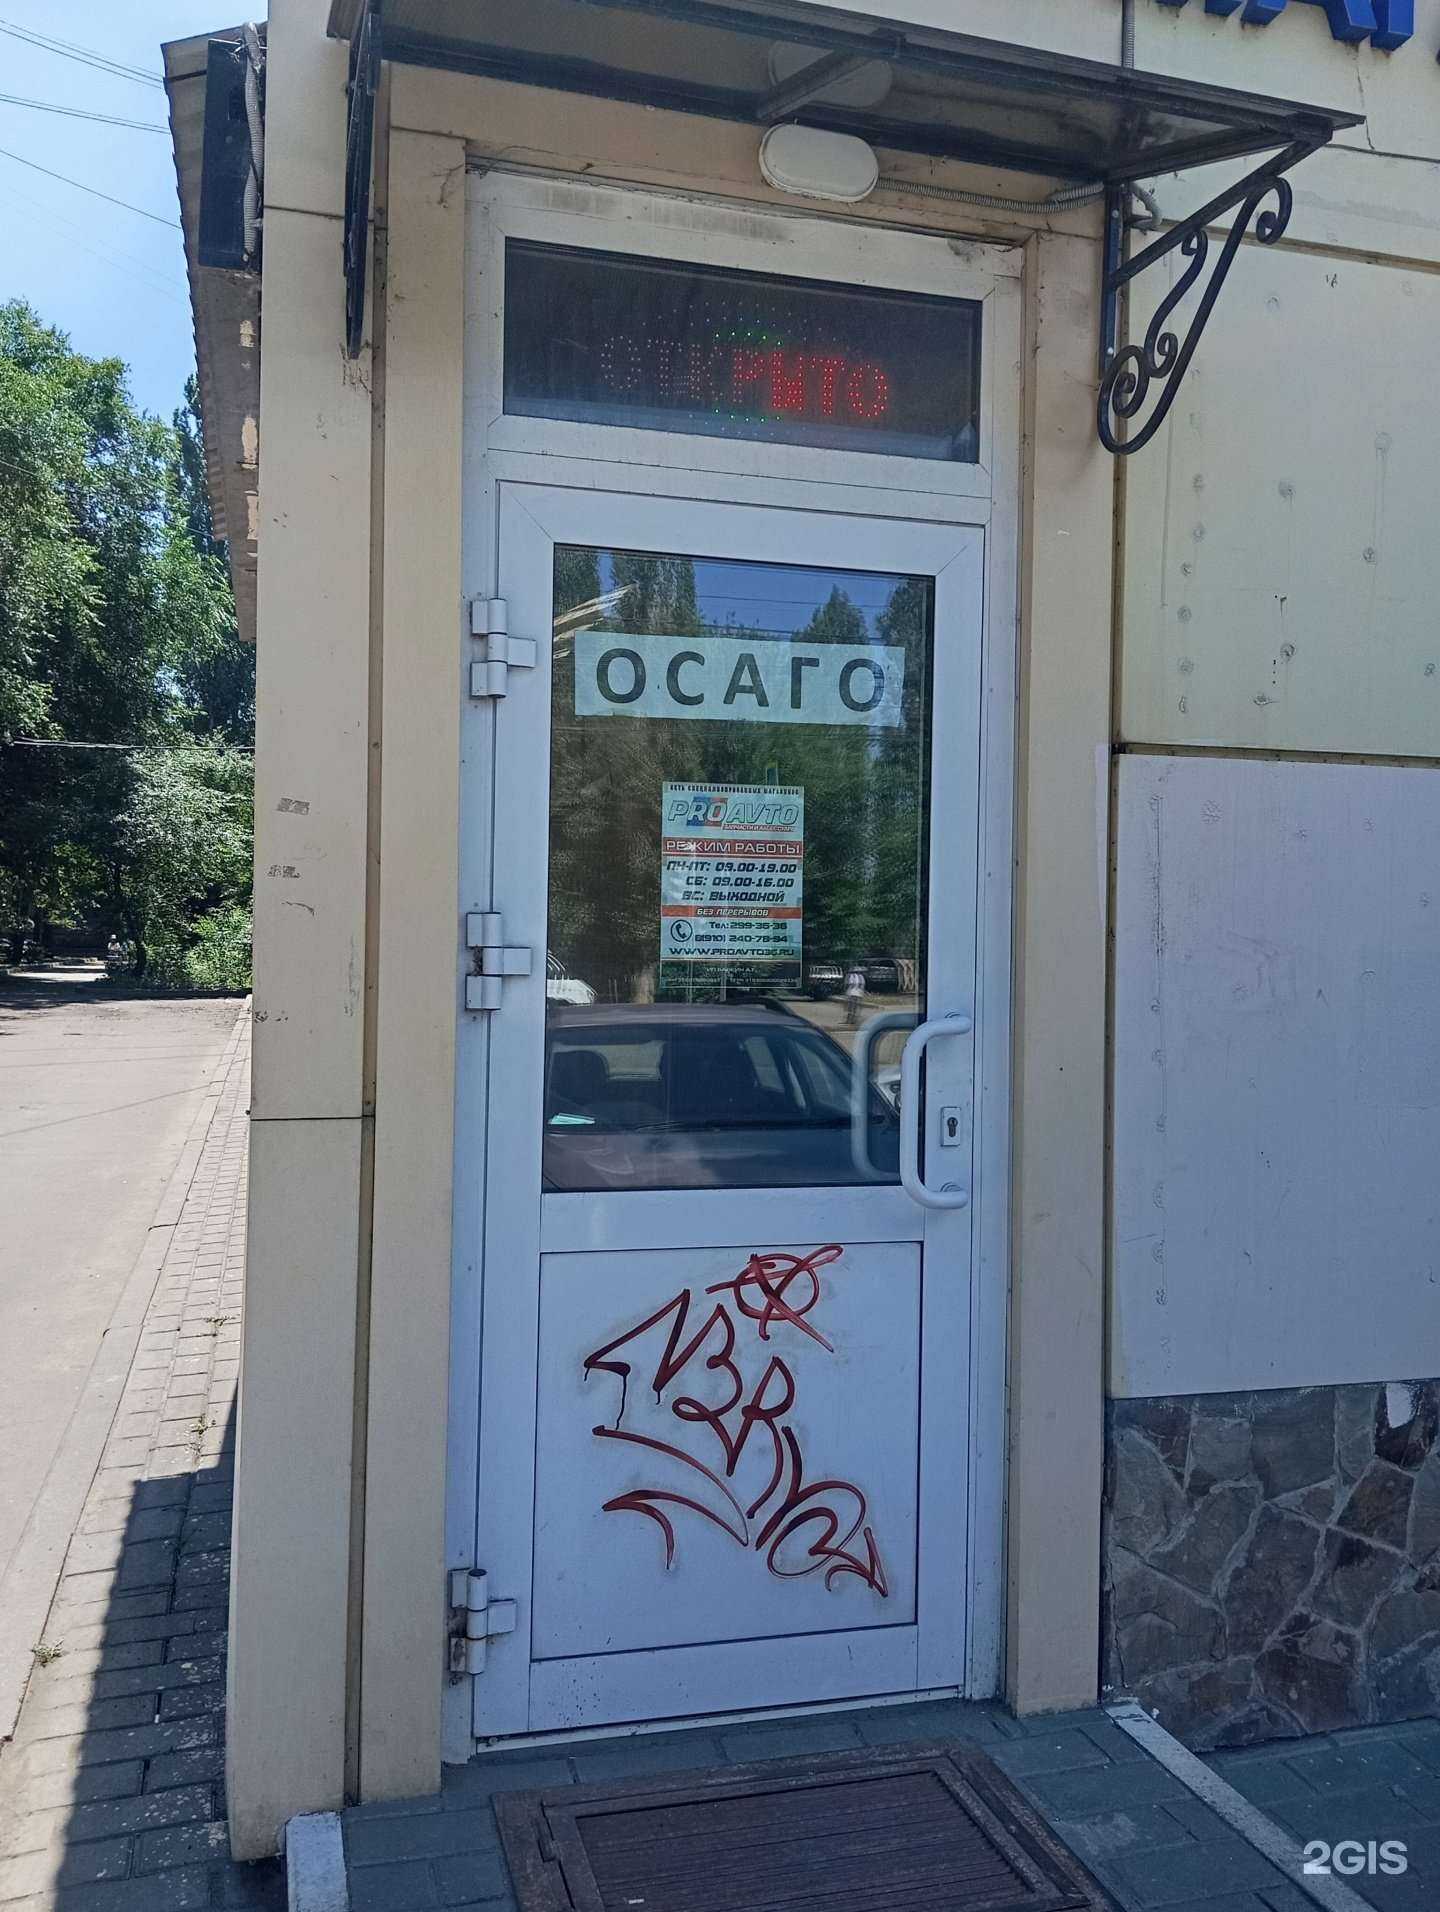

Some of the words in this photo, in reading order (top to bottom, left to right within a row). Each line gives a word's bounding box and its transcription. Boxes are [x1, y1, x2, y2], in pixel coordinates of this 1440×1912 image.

[596, 648, 886, 712] ОСАГО
[668, 799, 799, 825] PROAVTO
[666, 840, 731, 851] РЕЖИМ
[735, 842, 800, 854] РАБОТЫ
[715, 862, 797, 873] 09.00-19.00
[685, 876, 708, 886] СБ:
[712, 877, 794, 888] 09.00-16.00
[681, 891, 704, 901] ВС:
[709, 891, 785, 902] ВЫХОДНОЙ
[716, 908, 769, 916] ПЕРЕРЫВОВ
